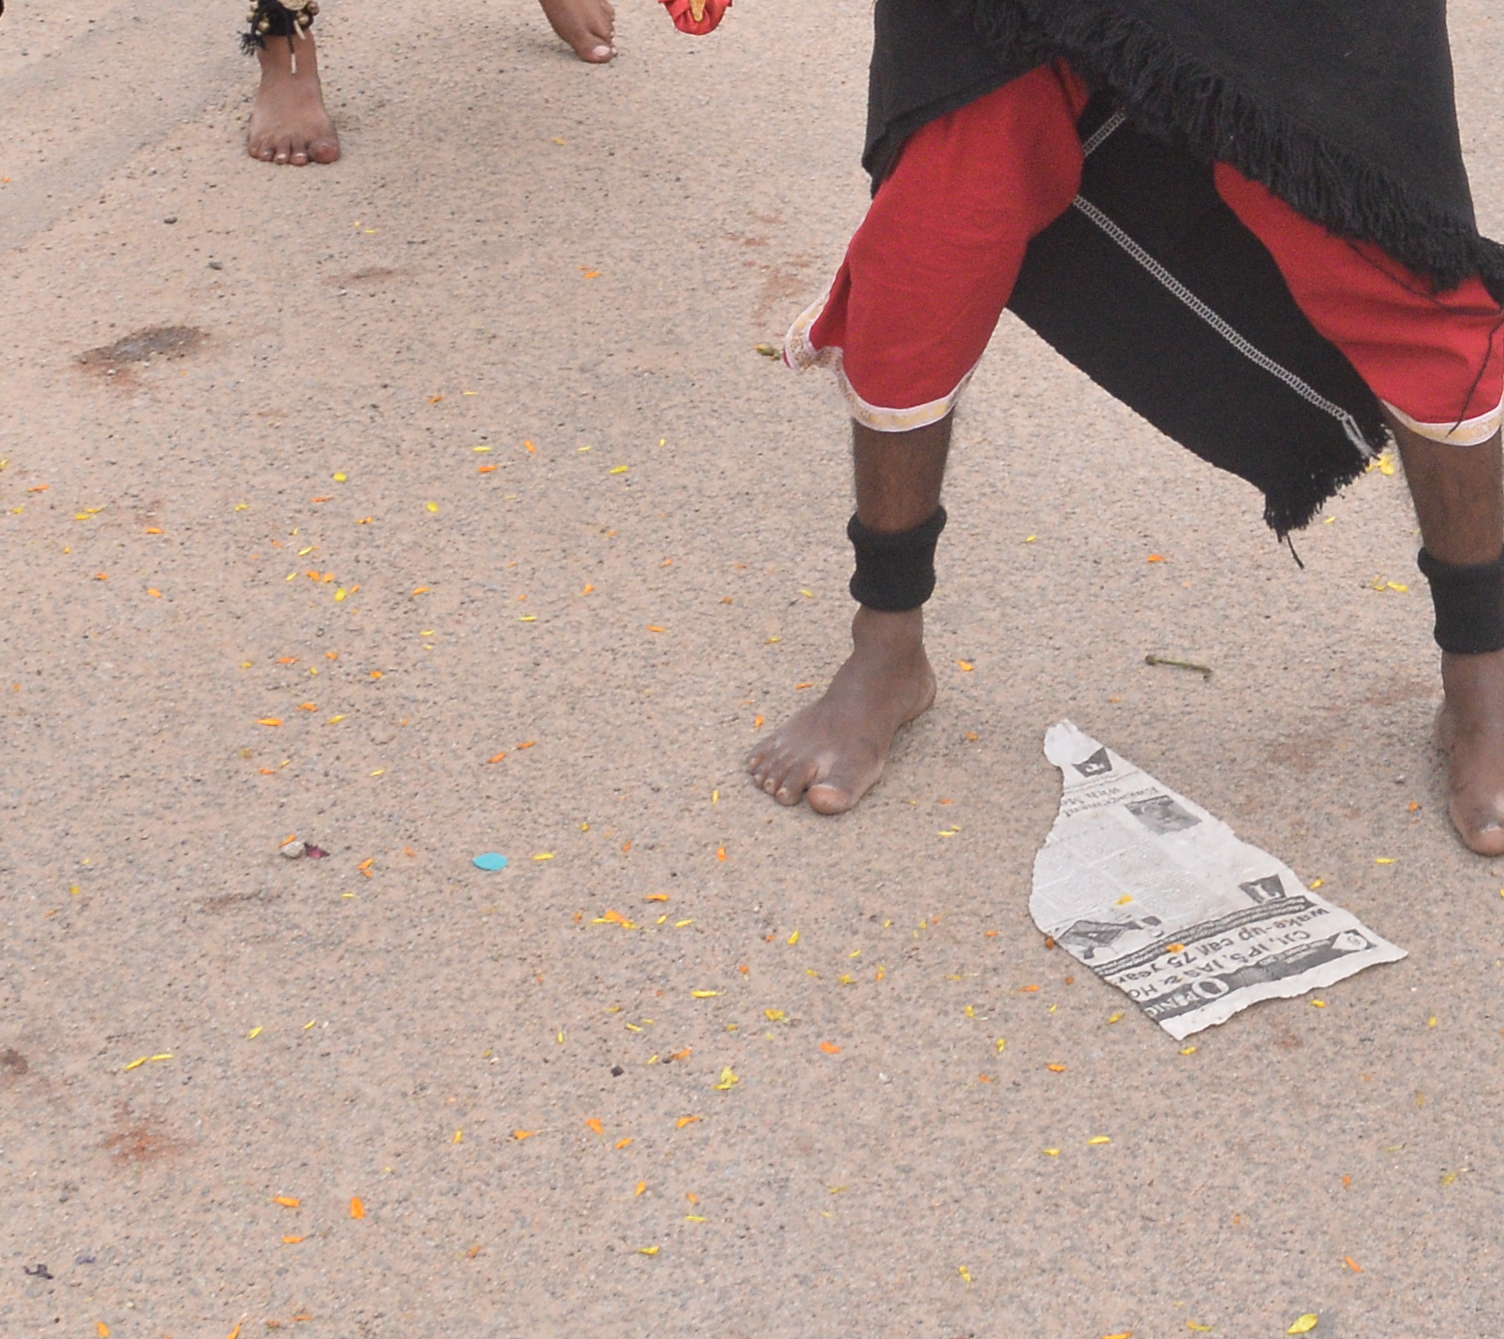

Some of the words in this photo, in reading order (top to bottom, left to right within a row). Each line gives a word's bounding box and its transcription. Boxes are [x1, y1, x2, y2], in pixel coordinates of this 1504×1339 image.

[1238, 907, 1330, 941] wake-up
[1167, 953, 1196, 969] 75
[1115, 963, 1165, 983] year
